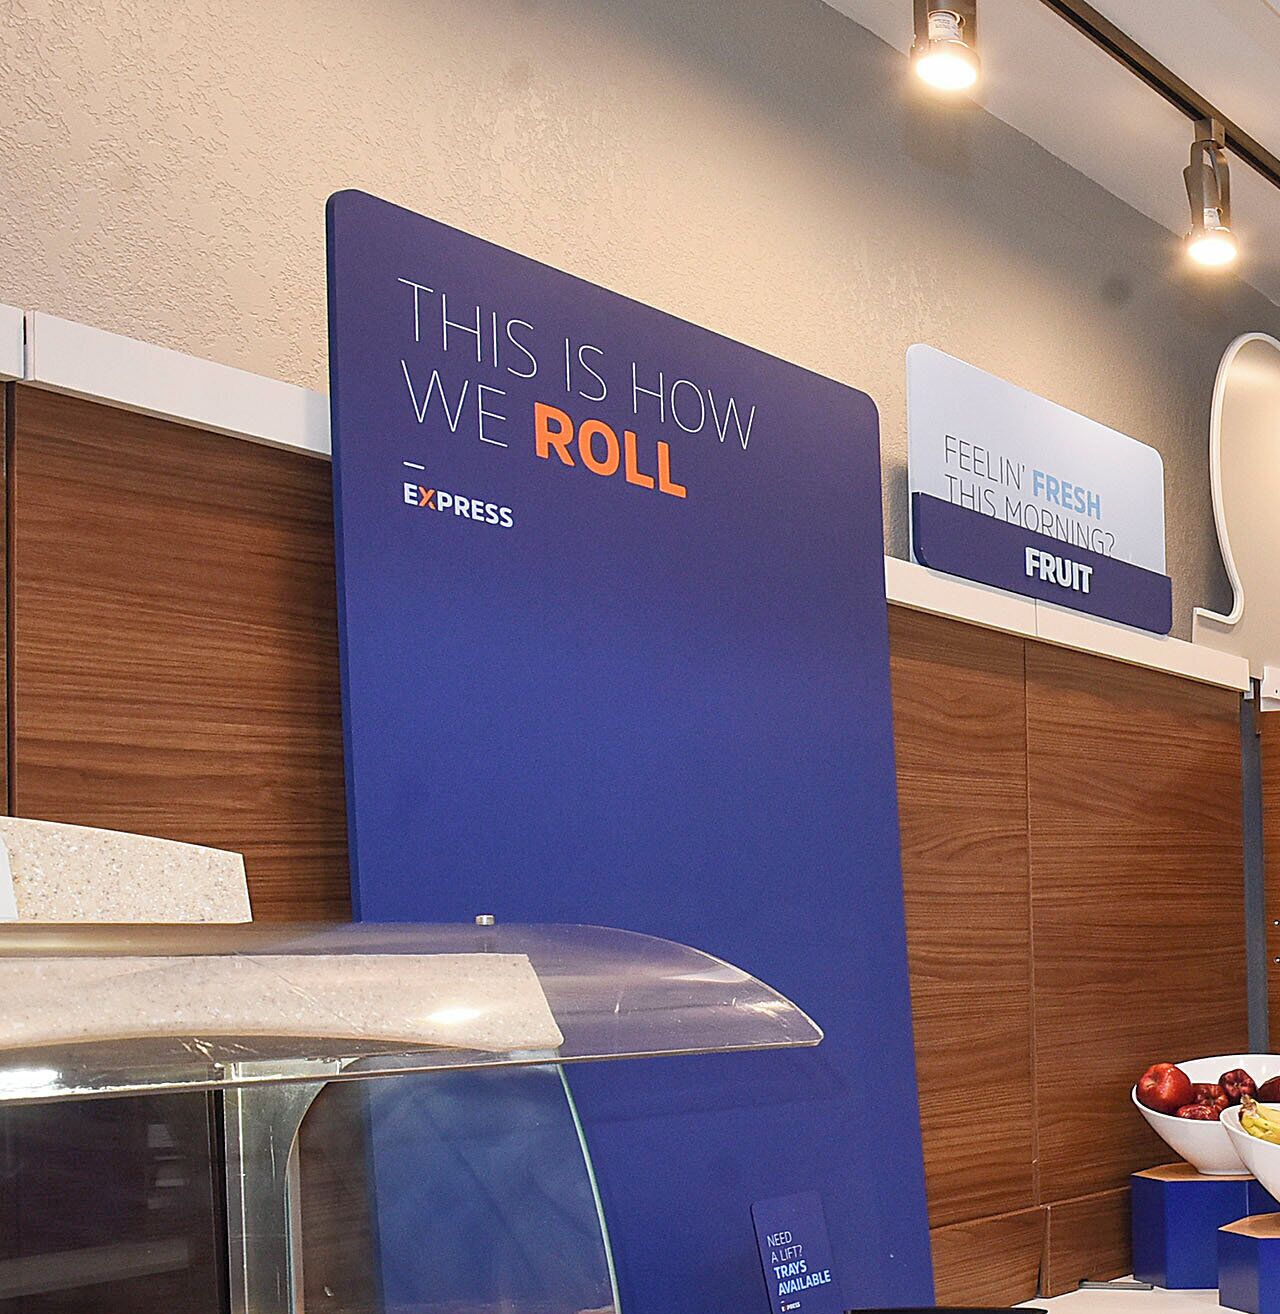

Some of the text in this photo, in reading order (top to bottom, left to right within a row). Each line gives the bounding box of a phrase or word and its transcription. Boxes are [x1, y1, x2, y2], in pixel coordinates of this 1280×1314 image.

[398, 277, 756, 450] THIS IS HOW
[401, 359, 688, 499] WE ROLL
[944, 434, 1101, 520] FEELIN' FRESH
[403, 482, 514, 528] EXPRESS
[944, 474, 1116, 557] THIS MORNING?
[1025, 546, 1093, 594] FRUIT
[766, 1230, 792, 1248] NEED
[771, 1244, 803, 1264] A LIFT?
[773, 1259, 807, 1280] TRAYS
[778, 1269, 832, 1296] AVAILABLE
